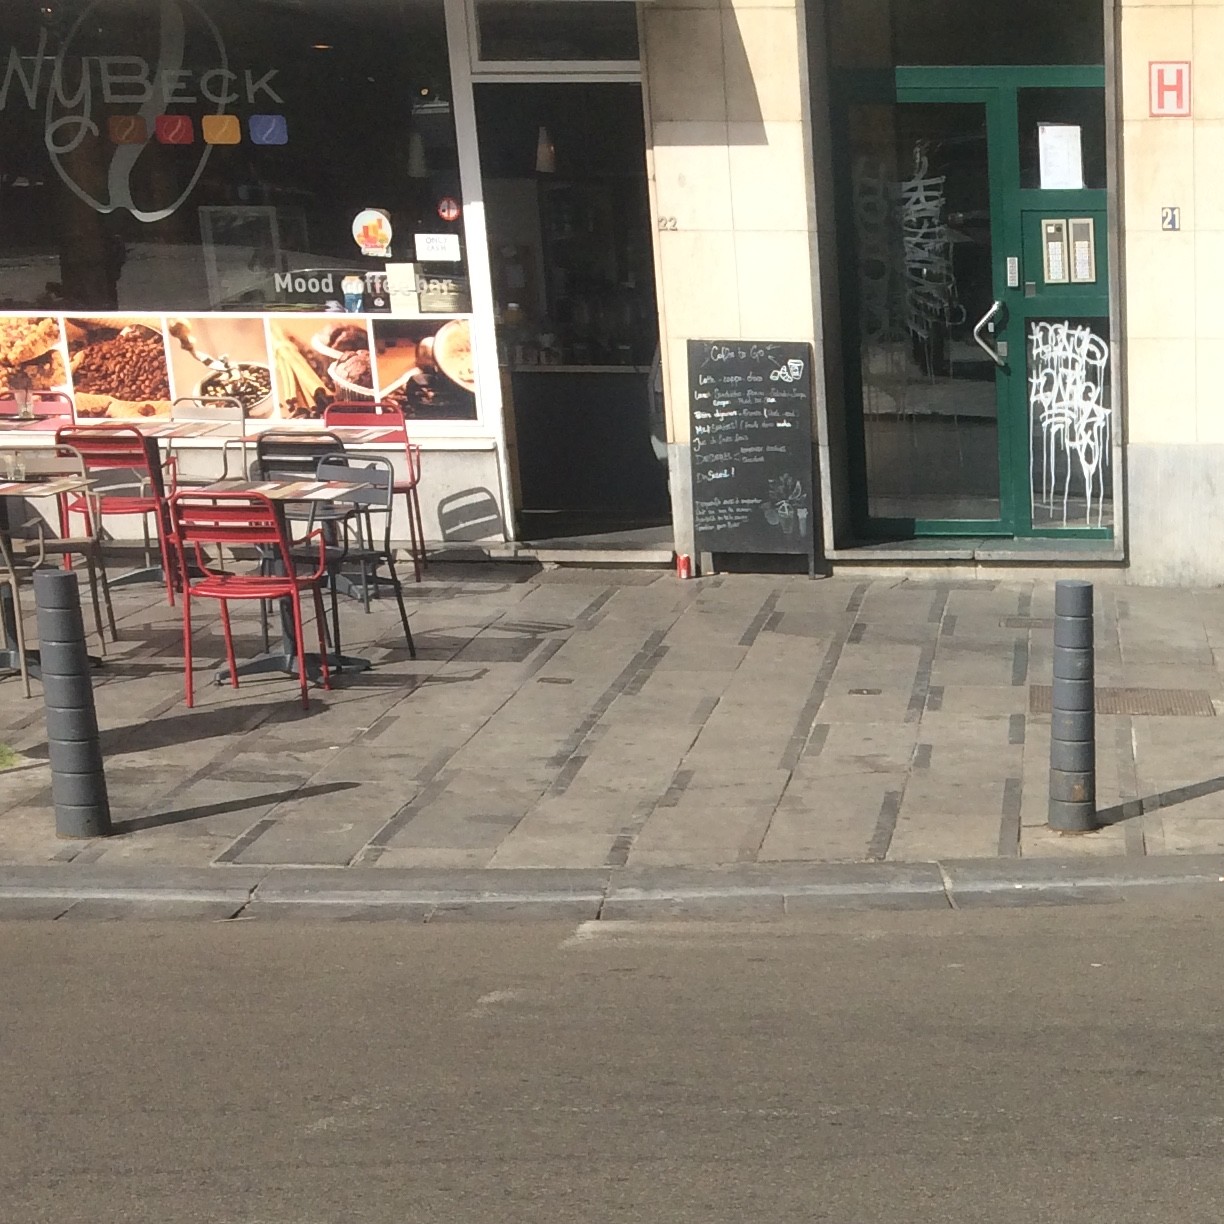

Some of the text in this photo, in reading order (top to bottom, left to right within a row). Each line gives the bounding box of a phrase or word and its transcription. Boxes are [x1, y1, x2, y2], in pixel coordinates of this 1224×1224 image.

[1158, 69, 1183, 109] H
[658, 216, 678, 231] 22
[1162, 208, 1180, 229] 21
[425, 236, 447, 244] ONLY
[274, 273, 334, 293] Mood
[415, 274, 453, 296] bar
